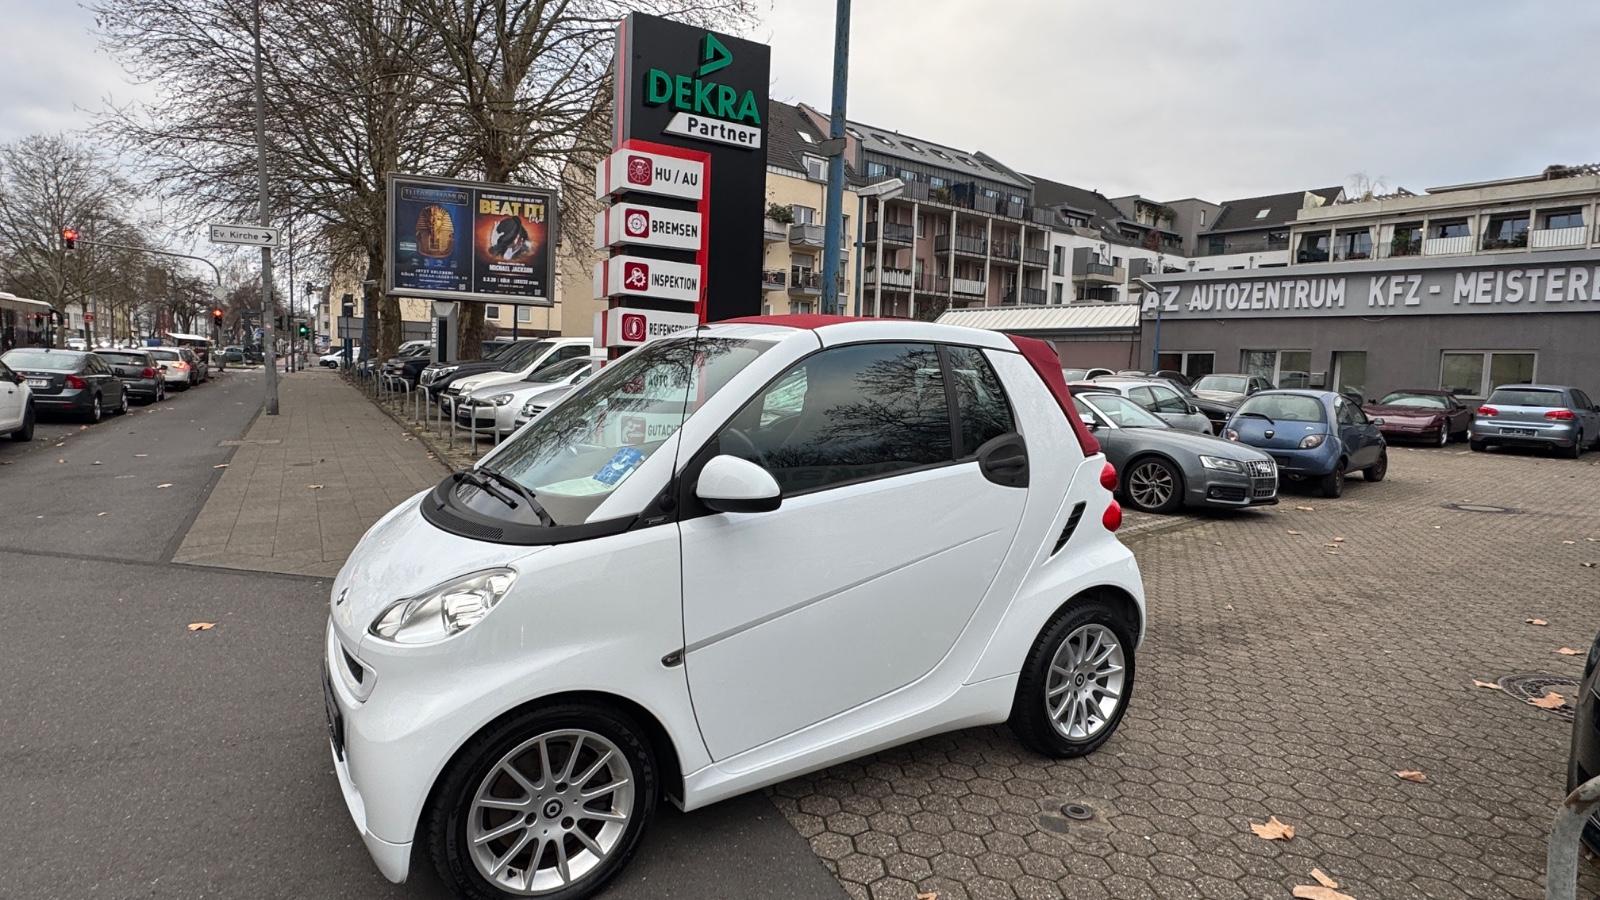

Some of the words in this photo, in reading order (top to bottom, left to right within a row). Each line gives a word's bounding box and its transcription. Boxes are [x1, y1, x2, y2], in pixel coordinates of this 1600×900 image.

[649, 68, 761, 125] DEKRA
[687, 117, 757, 145] Partner
[655, 166, 672, 182] HU
[673, 169, 680, 185] /
[682, 171, 698, 186] AU
[480, 198, 522, 217] BEAT
[213, 229, 226, 239] Ev.
[229, 231, 259, 241] Kirche
[651, 219, 698, 238] BREMSEN
[651, 273, 697, 291] INSPEKTION
[1188, 277, 1347, 311] AUTOZENTRUM
[1367, 274, 1423, 306] KFZ
